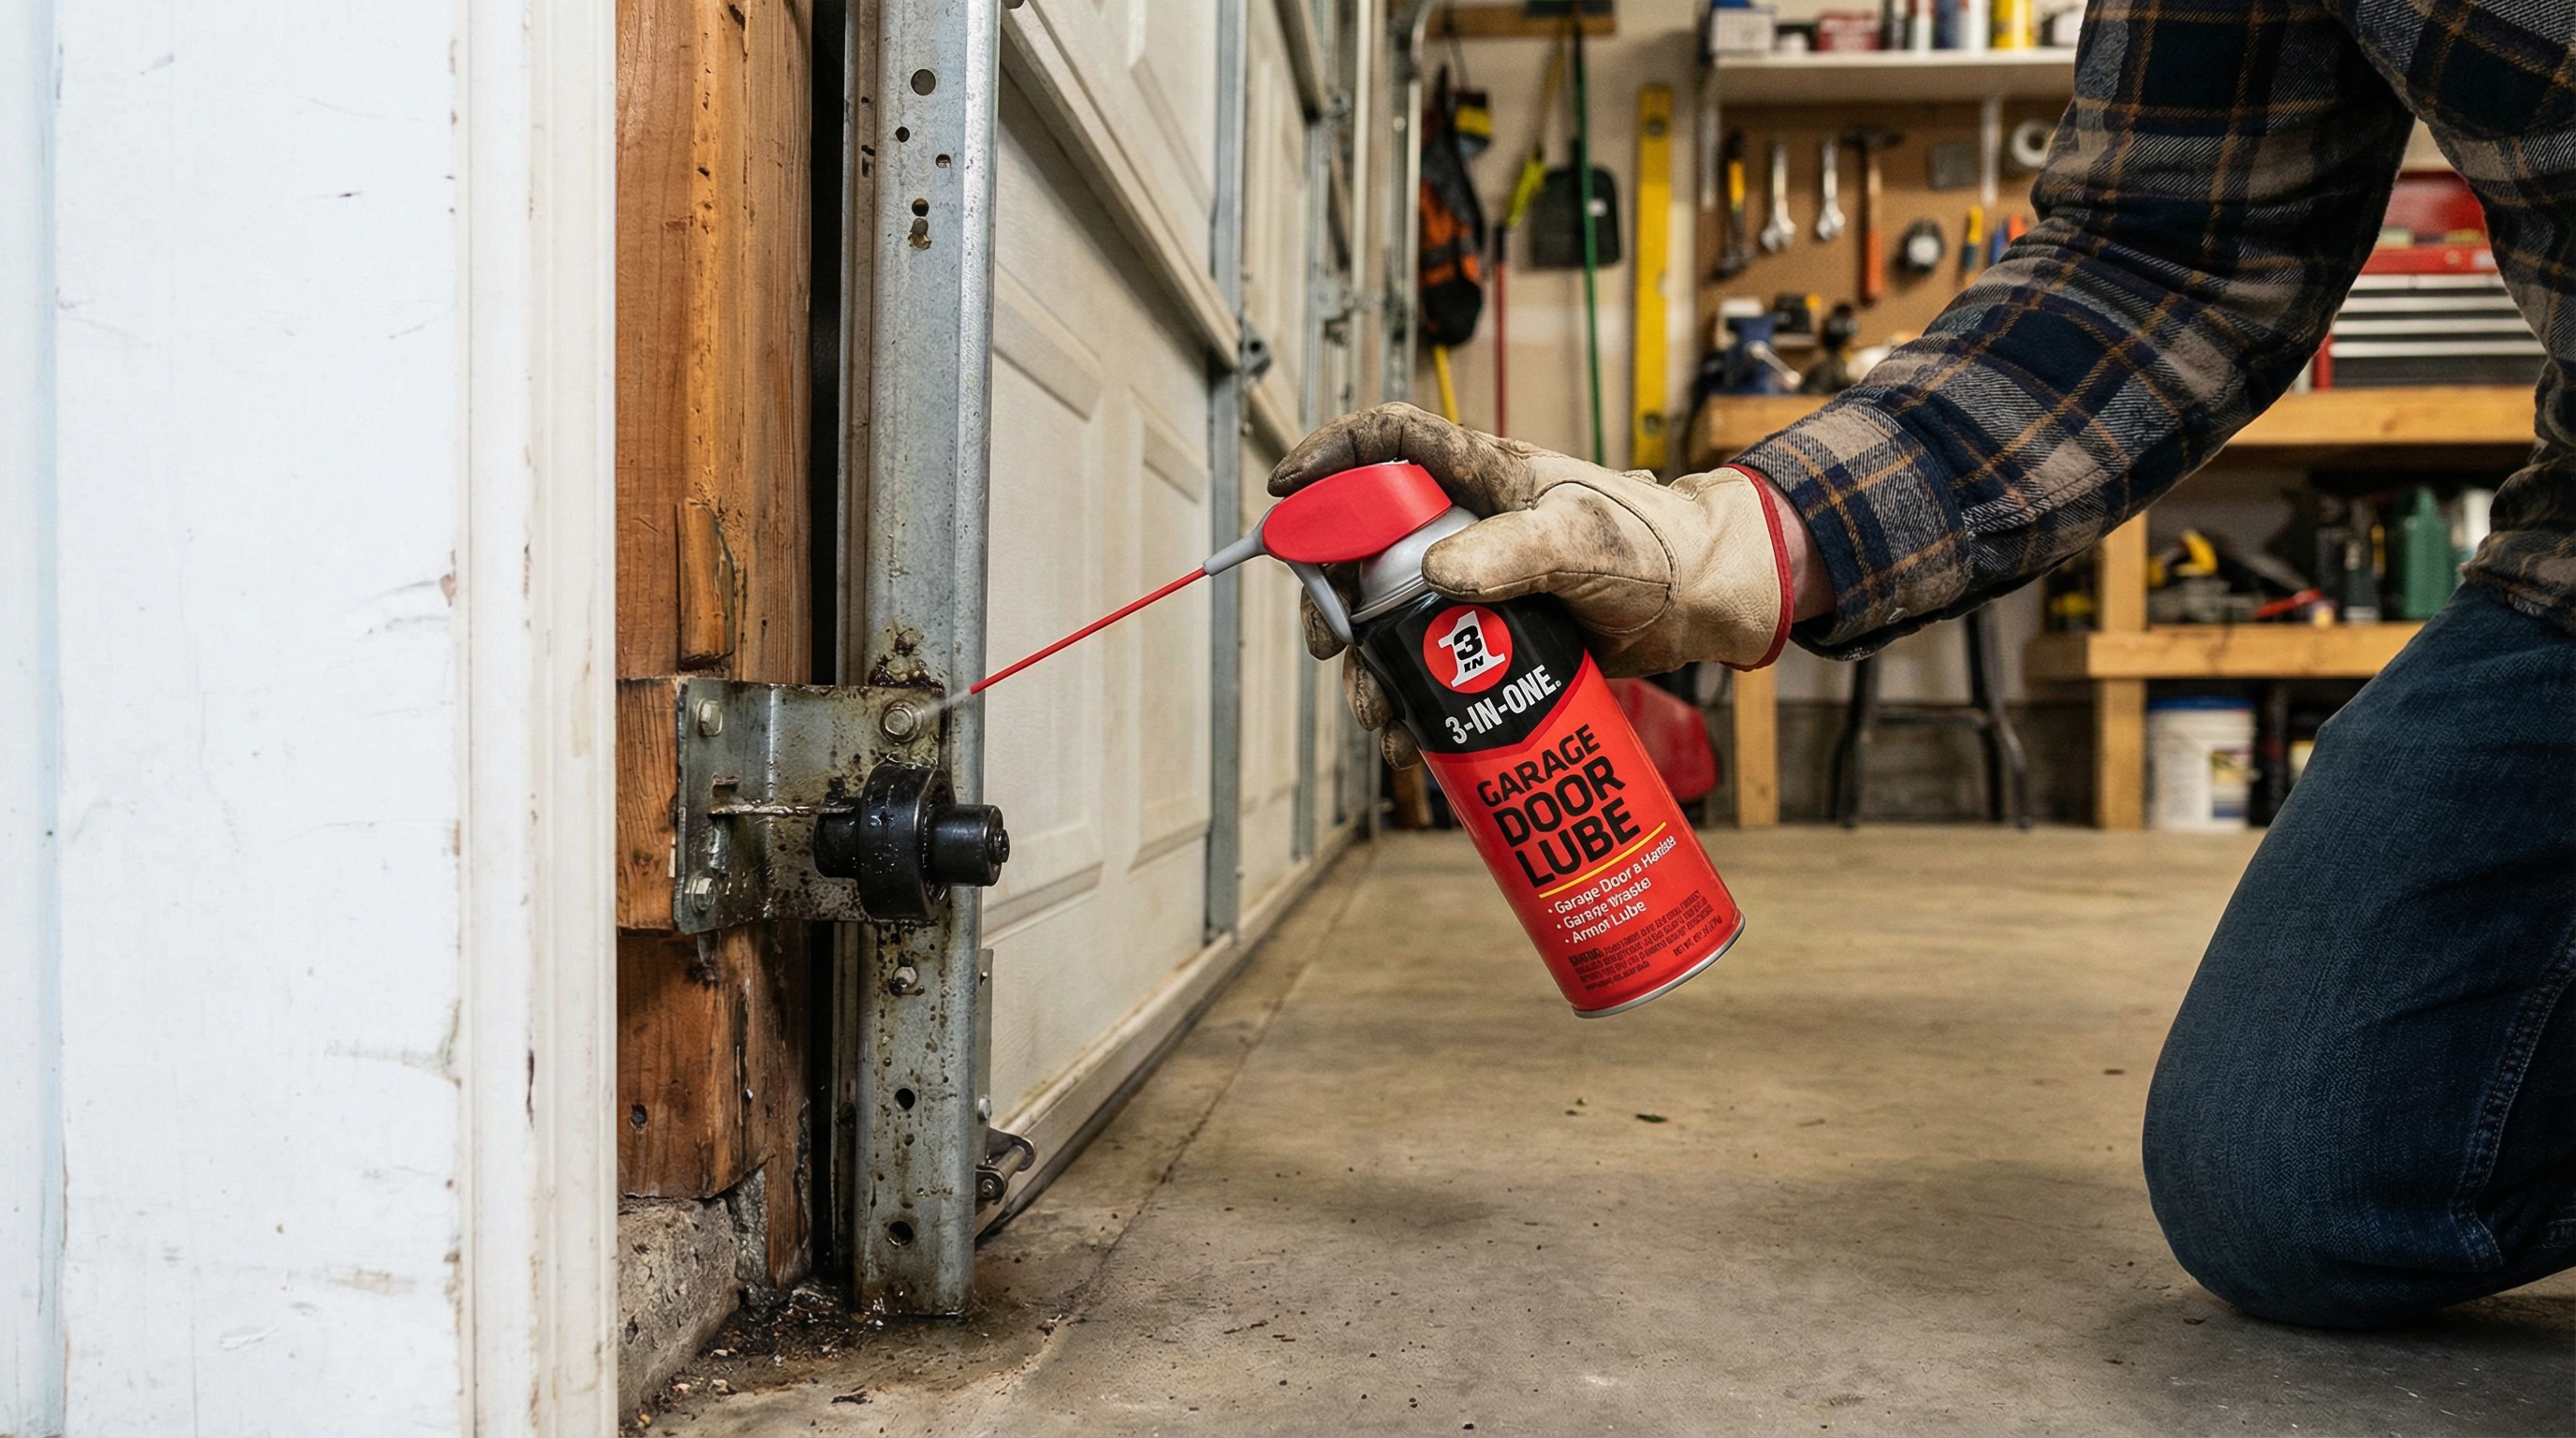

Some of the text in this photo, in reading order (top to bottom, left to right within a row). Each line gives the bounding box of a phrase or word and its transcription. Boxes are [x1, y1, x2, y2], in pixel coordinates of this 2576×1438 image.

[1453, 625, 1483, 661] 3
[1464, 655, 1485, 673] IN
[1476, 724, 1602, 808] GARAGE
[1492, 756, 1627, 848] DOOR
[1515, 797, 1642, 888] LUBE
[1555, 887, 1601, 914] Garage
[1599, 867, 1632, 893] Door
[1610, 901, 1647, 926] Lube
